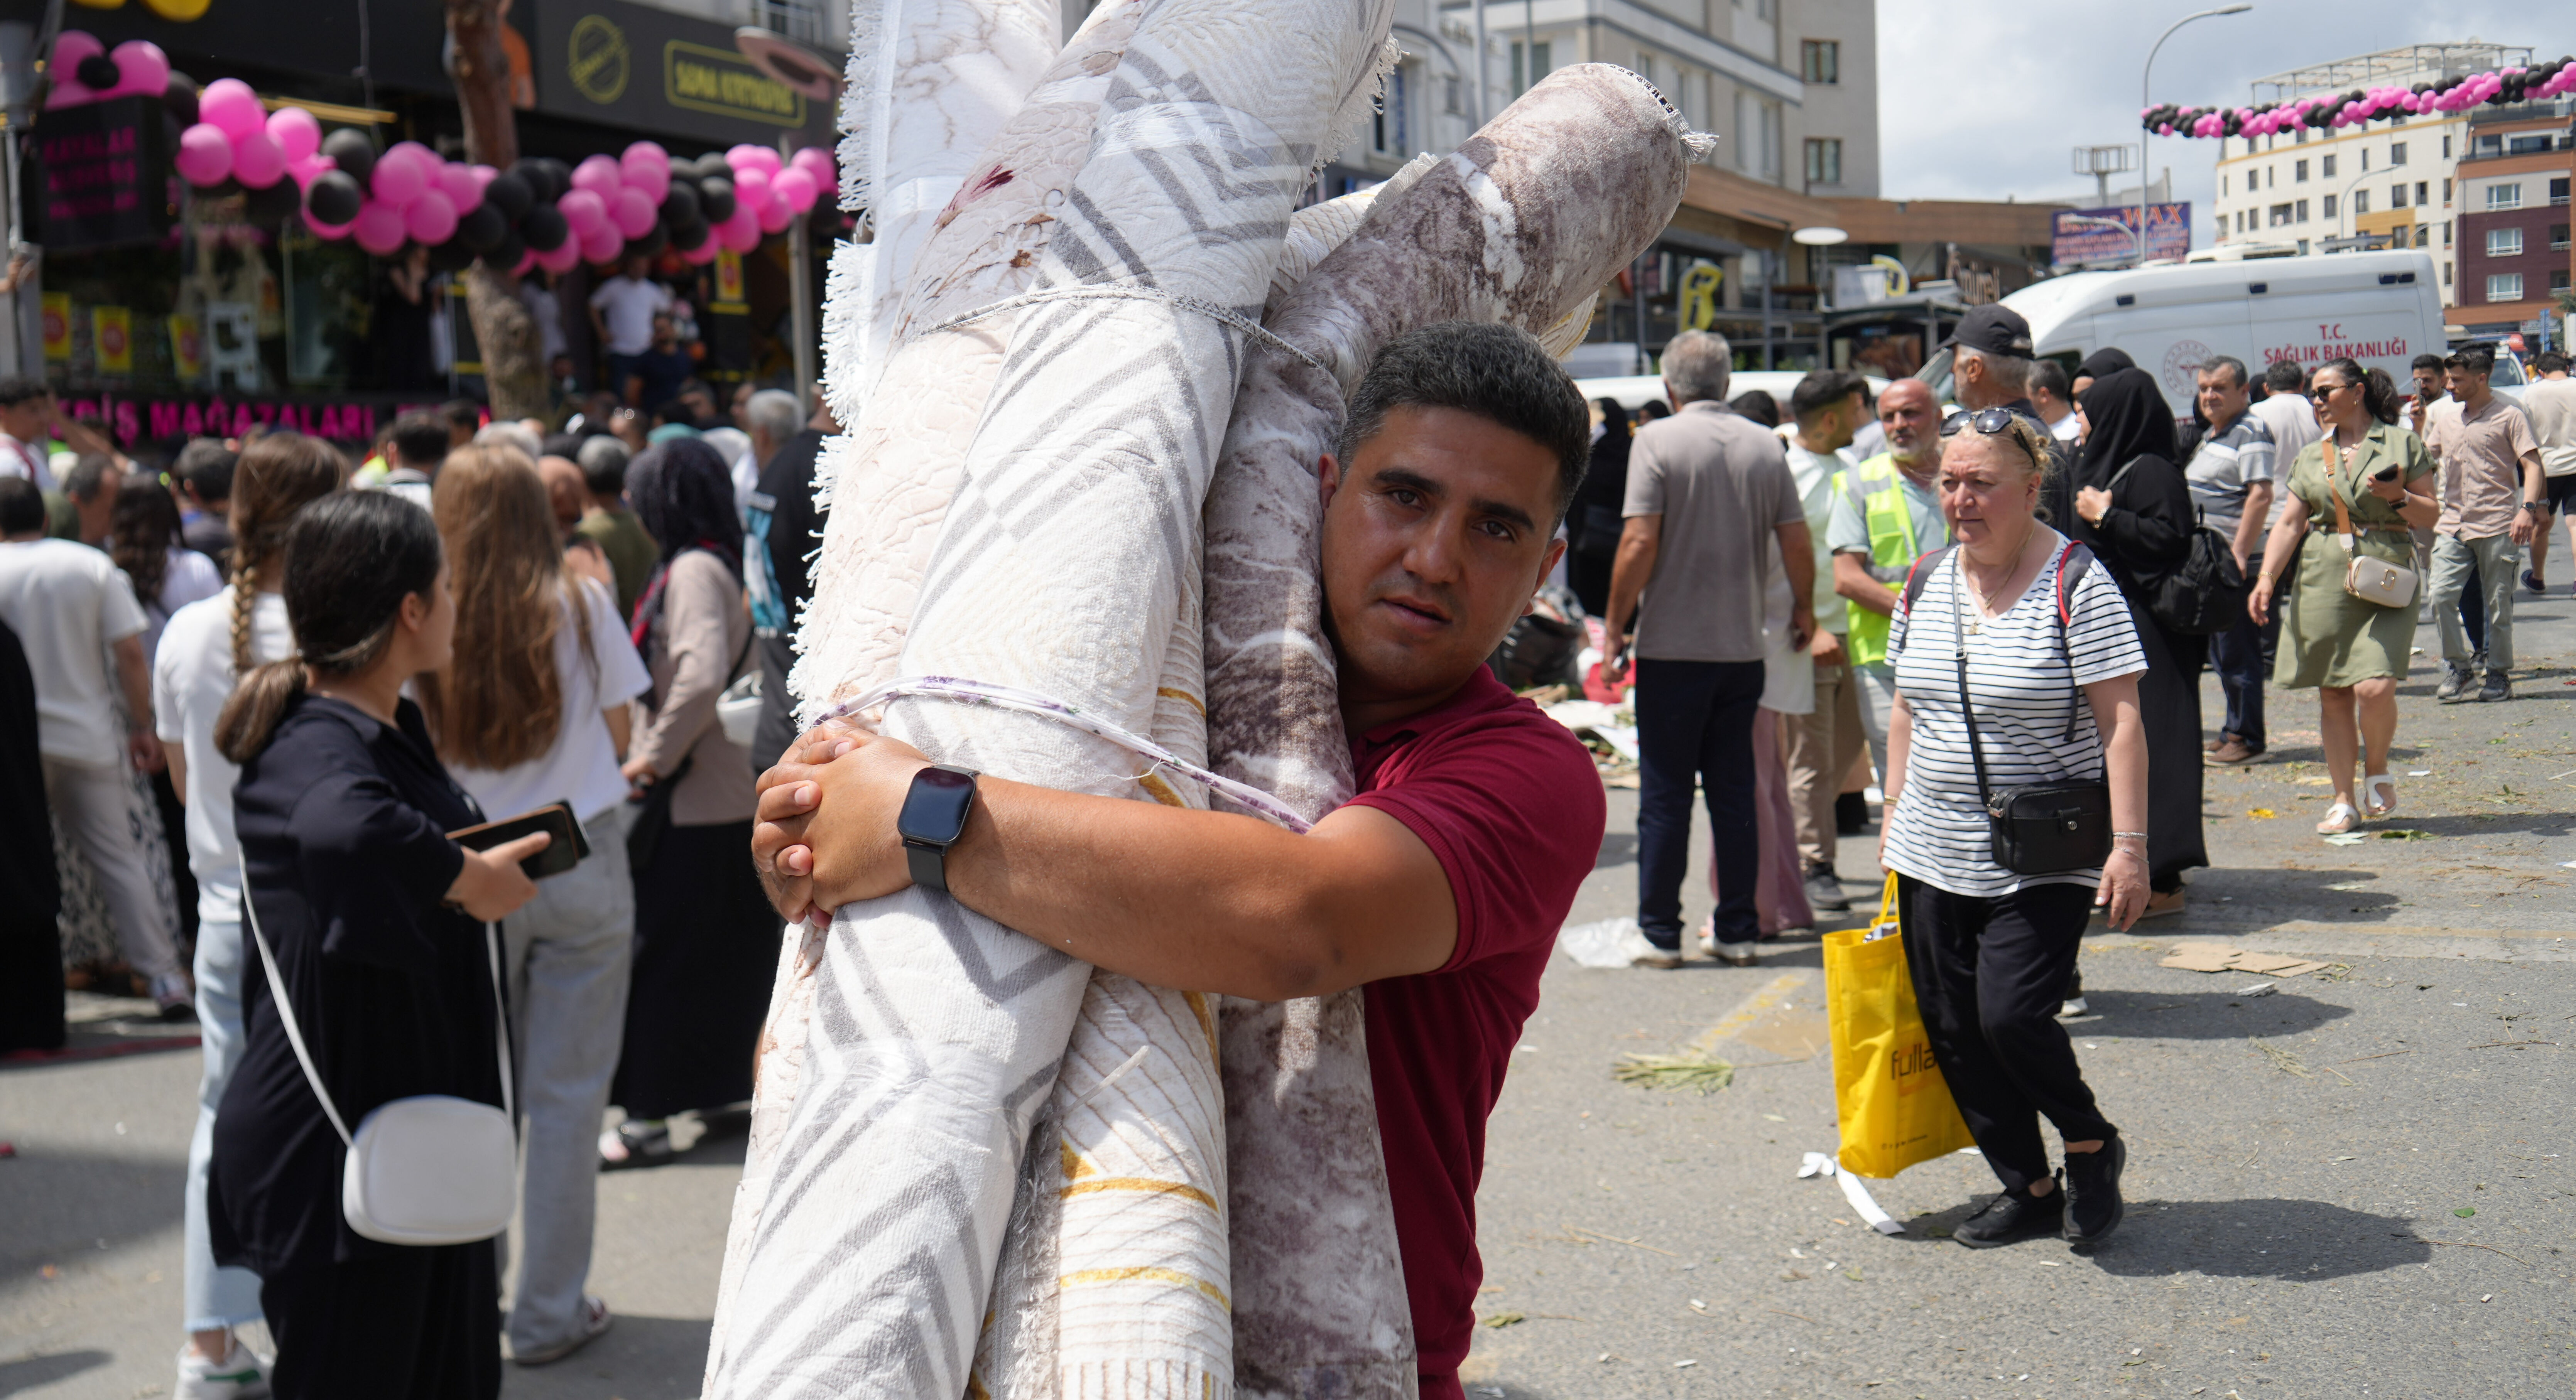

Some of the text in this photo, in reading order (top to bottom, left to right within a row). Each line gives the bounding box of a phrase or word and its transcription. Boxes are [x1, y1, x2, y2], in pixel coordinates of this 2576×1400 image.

[2122, 204, 2184, 228] WAX
[2319, 324, 2347, 340] T.C.
[2264, 336, 2407, 364] SAĞLIK BAKANLIĞI
